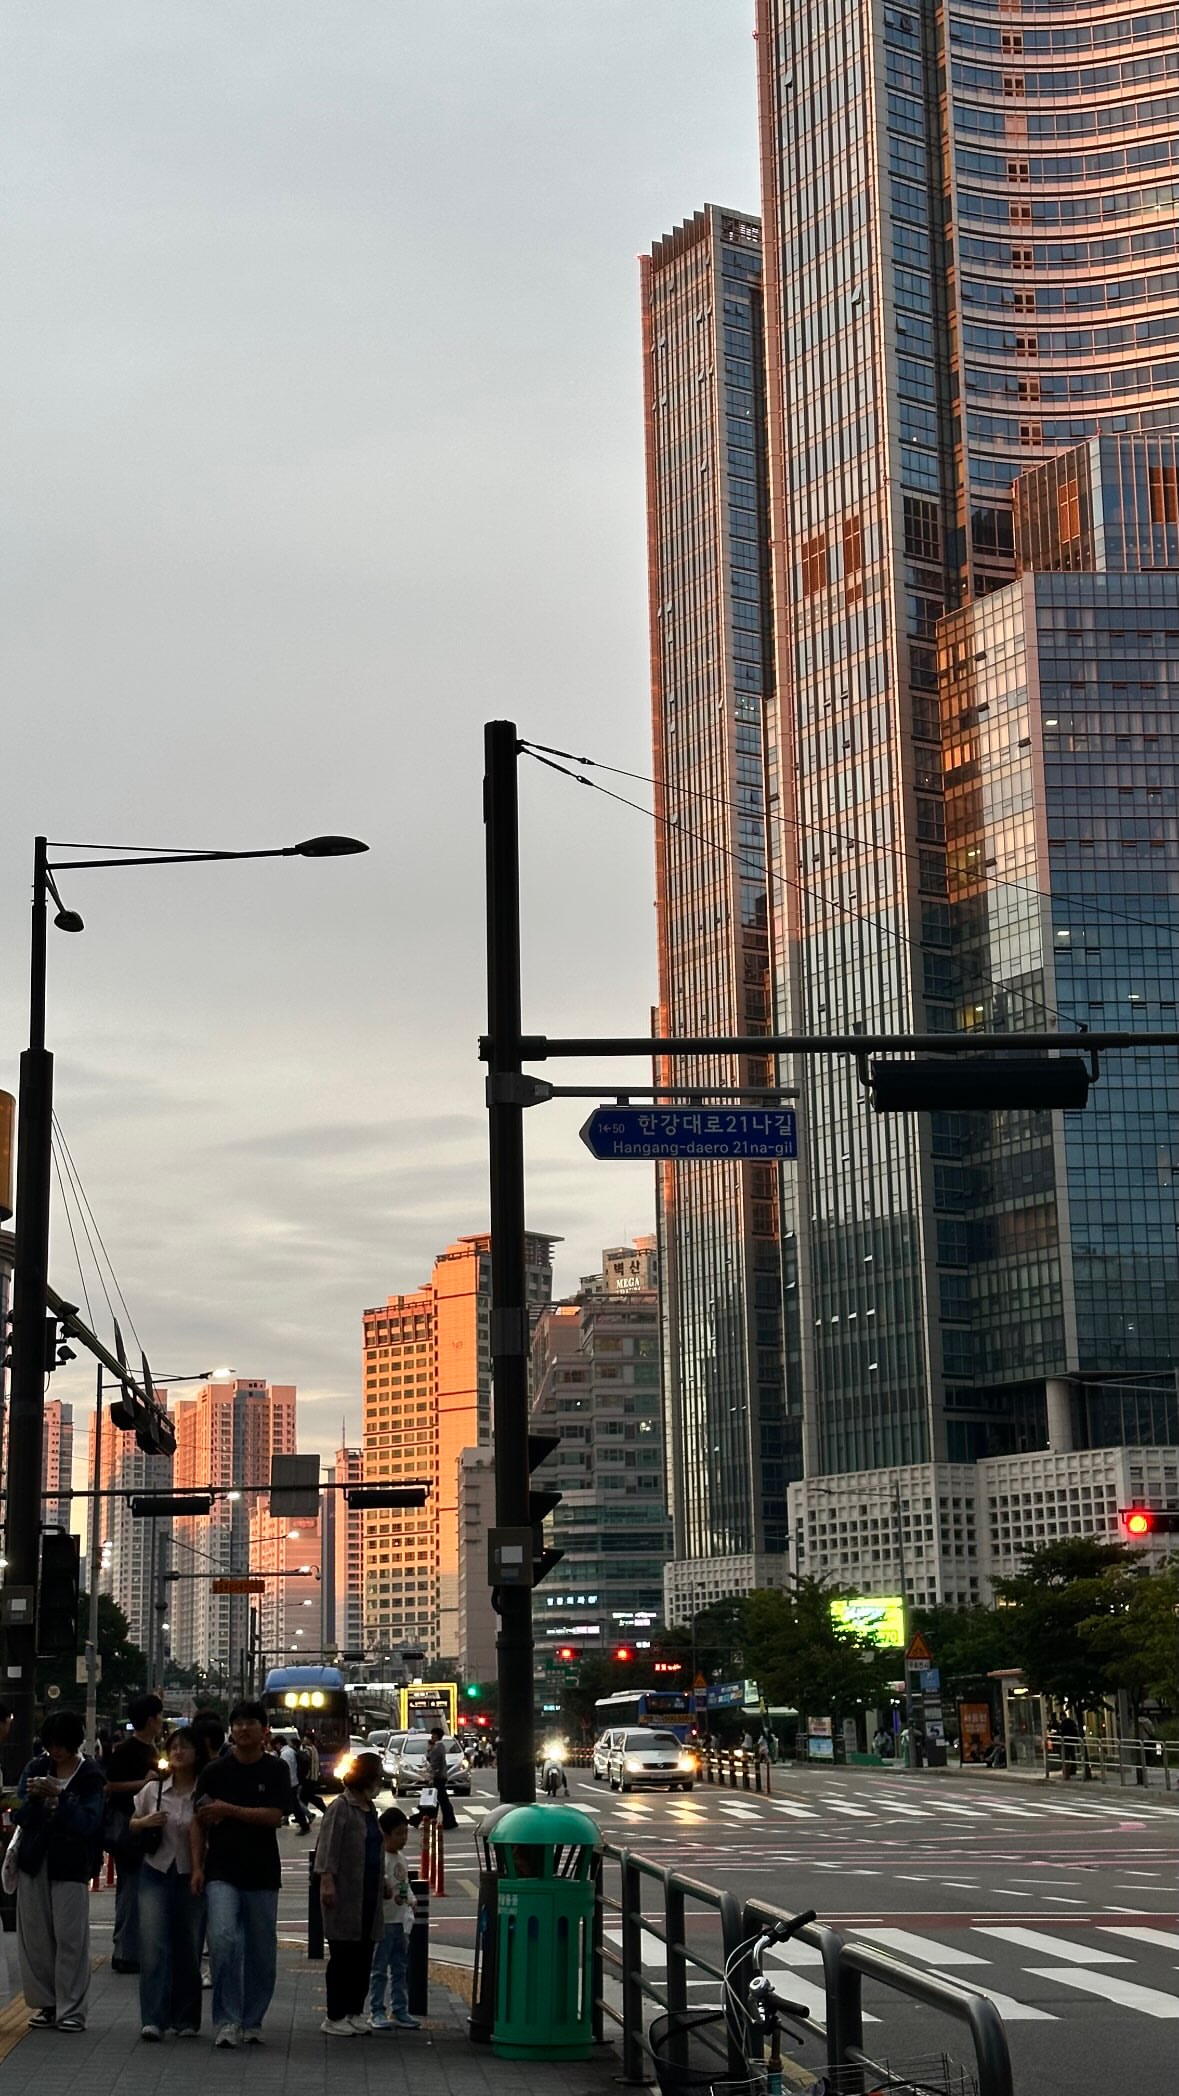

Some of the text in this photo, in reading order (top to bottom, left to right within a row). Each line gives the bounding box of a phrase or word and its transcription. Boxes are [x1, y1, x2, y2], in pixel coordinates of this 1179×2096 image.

[637, 1113, 792, 1136] 한강대로21나길
[613, 1140, 793, 1157] Hangang-daero 21na-gil
[616, 1277, 640, 1289] MEGA
